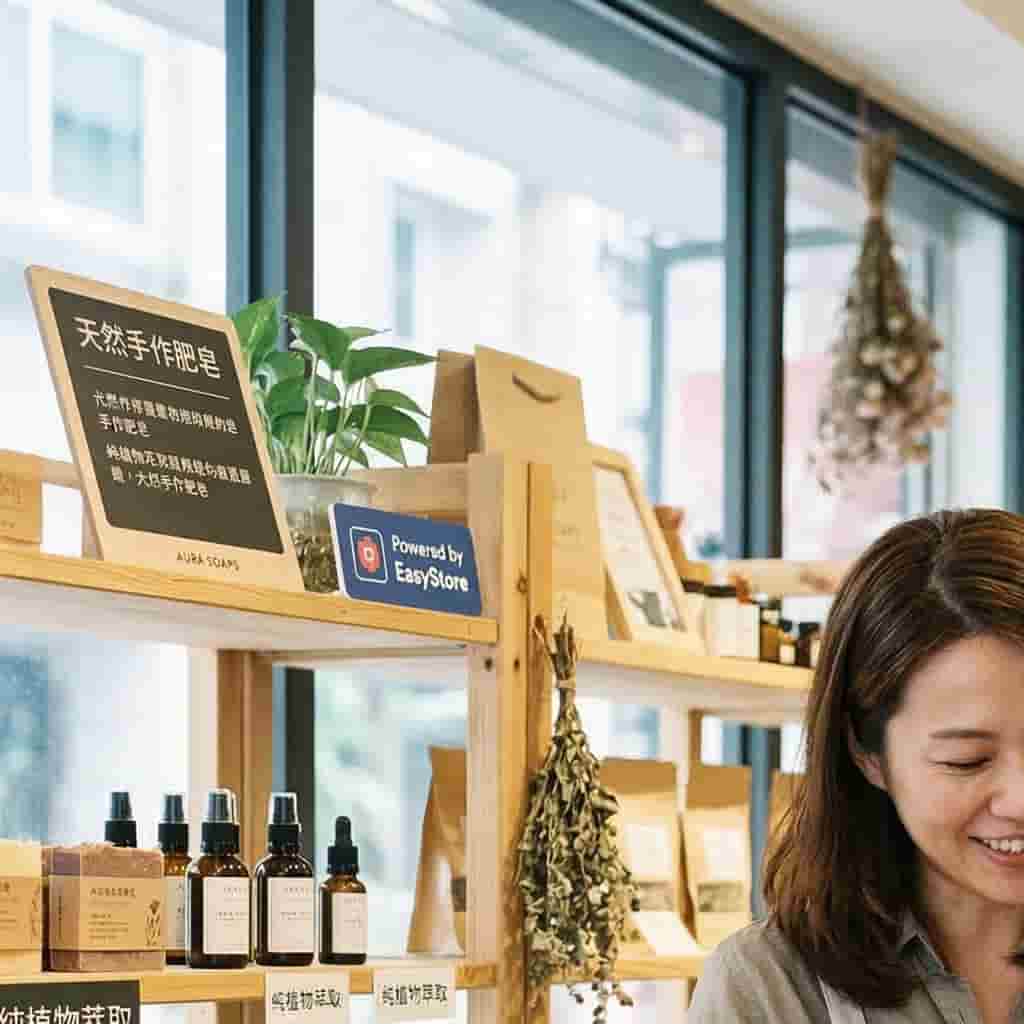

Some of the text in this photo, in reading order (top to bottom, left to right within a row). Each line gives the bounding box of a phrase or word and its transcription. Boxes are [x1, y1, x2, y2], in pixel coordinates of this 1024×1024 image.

[73, 316, 222, 379] 天然手作肥皂
[176, 551, 203, 566] AURA
[392, 534, 464, 568] Powered by
[394, 560, 469, 593] EasyStore
